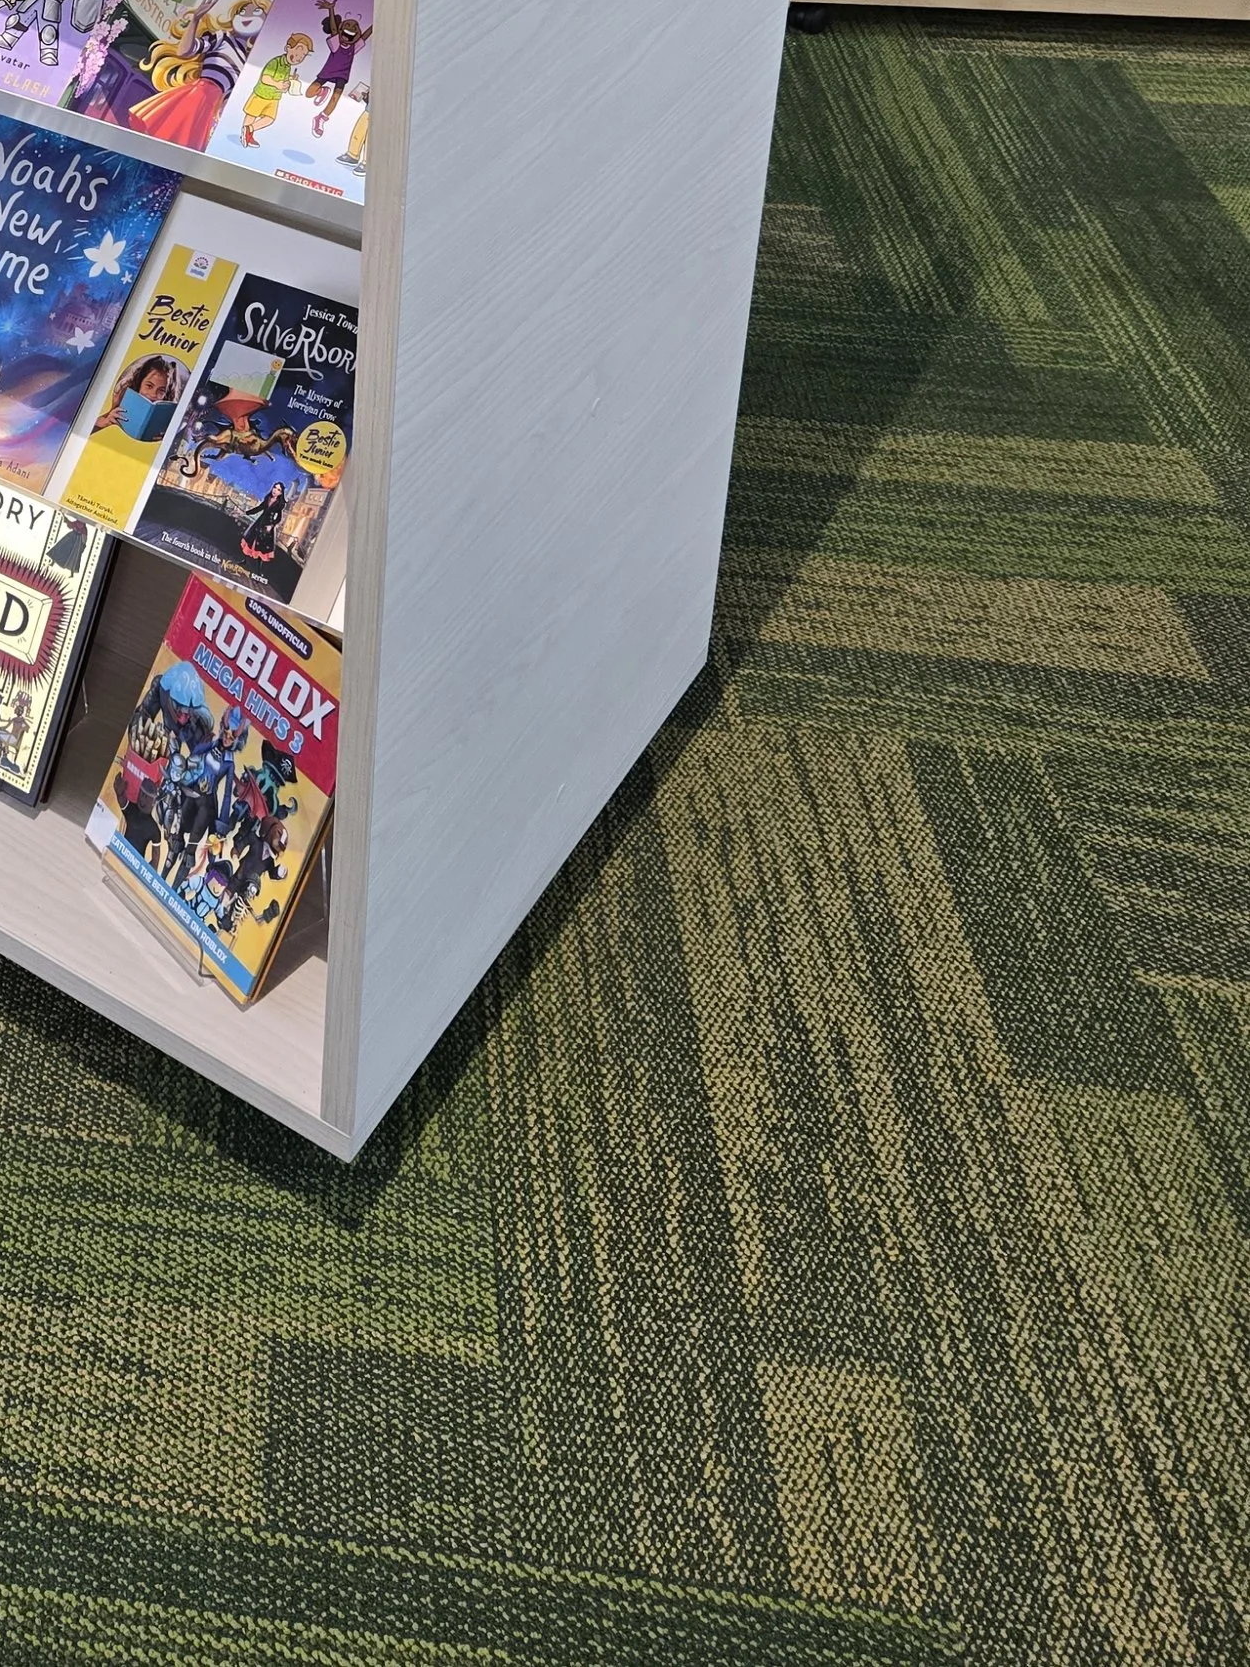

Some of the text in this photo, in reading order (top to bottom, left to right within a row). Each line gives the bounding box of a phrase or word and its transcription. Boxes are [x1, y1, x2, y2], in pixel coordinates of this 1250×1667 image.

[4, 72, 51, 98] CLASH
[147, 295, 211, 332] Bestie
[138, 316, 200, 354] Junior
[287, 396, 337, 422] Morrigan Crow
[295, 384, 343, 409] The Mystery of
[304, 441, 334, 459] Junior
[306, 429, 342, 448] Bestie
[6, 458, 31, 480] Adani
[248, 598, 309, 656] 100% UNOFFICIAL
[193, 593, 336, 741] ROBLOX
[192, 644, 305, 754] MEGA HITS 3
[111, 835, 228, 964] EATURING THE BEST GAMES ON ROBLOX
